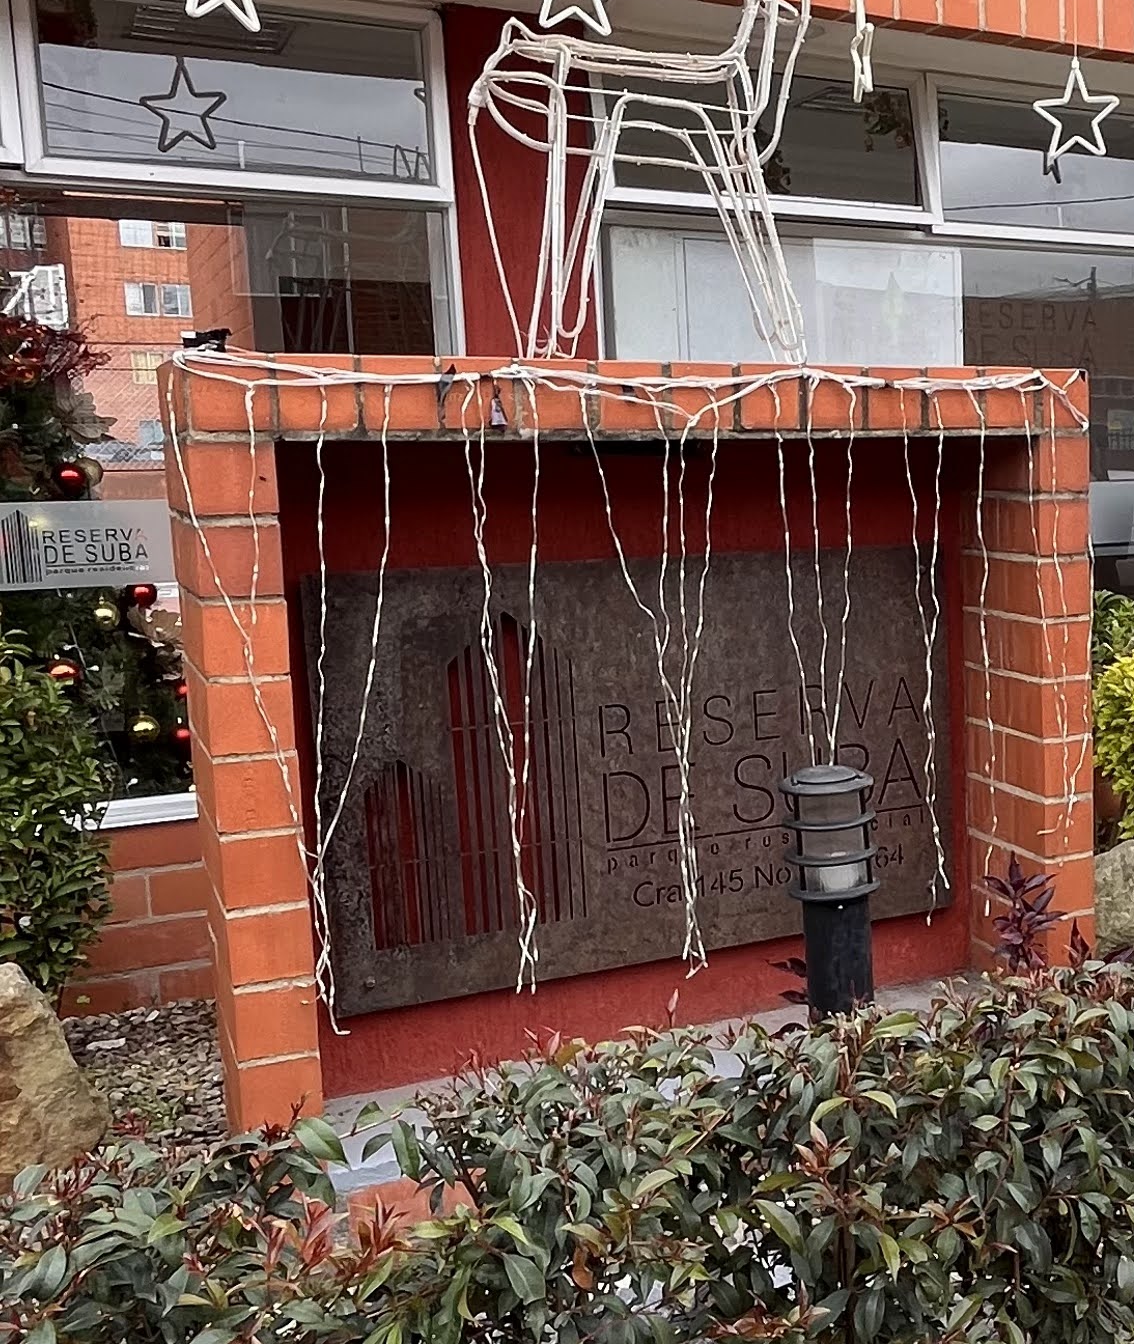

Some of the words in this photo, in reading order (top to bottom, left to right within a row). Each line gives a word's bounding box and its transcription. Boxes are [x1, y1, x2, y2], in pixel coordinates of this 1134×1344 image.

[42, 528, 148, 544] RESERVA
[44, 545, 75, 564] DE
[85, 543, 148, 563] SUBA
[46, 567, 84, 575] parque
[598, 676, 920, 757] RESERVA
[603, 762, 700, 843] DE
[606, 843, 720, 875] parqe
[745, 808, 924, 851] rescial
[633, 880, 683, 907] Cra
[695, 868, 744, 898] 145
